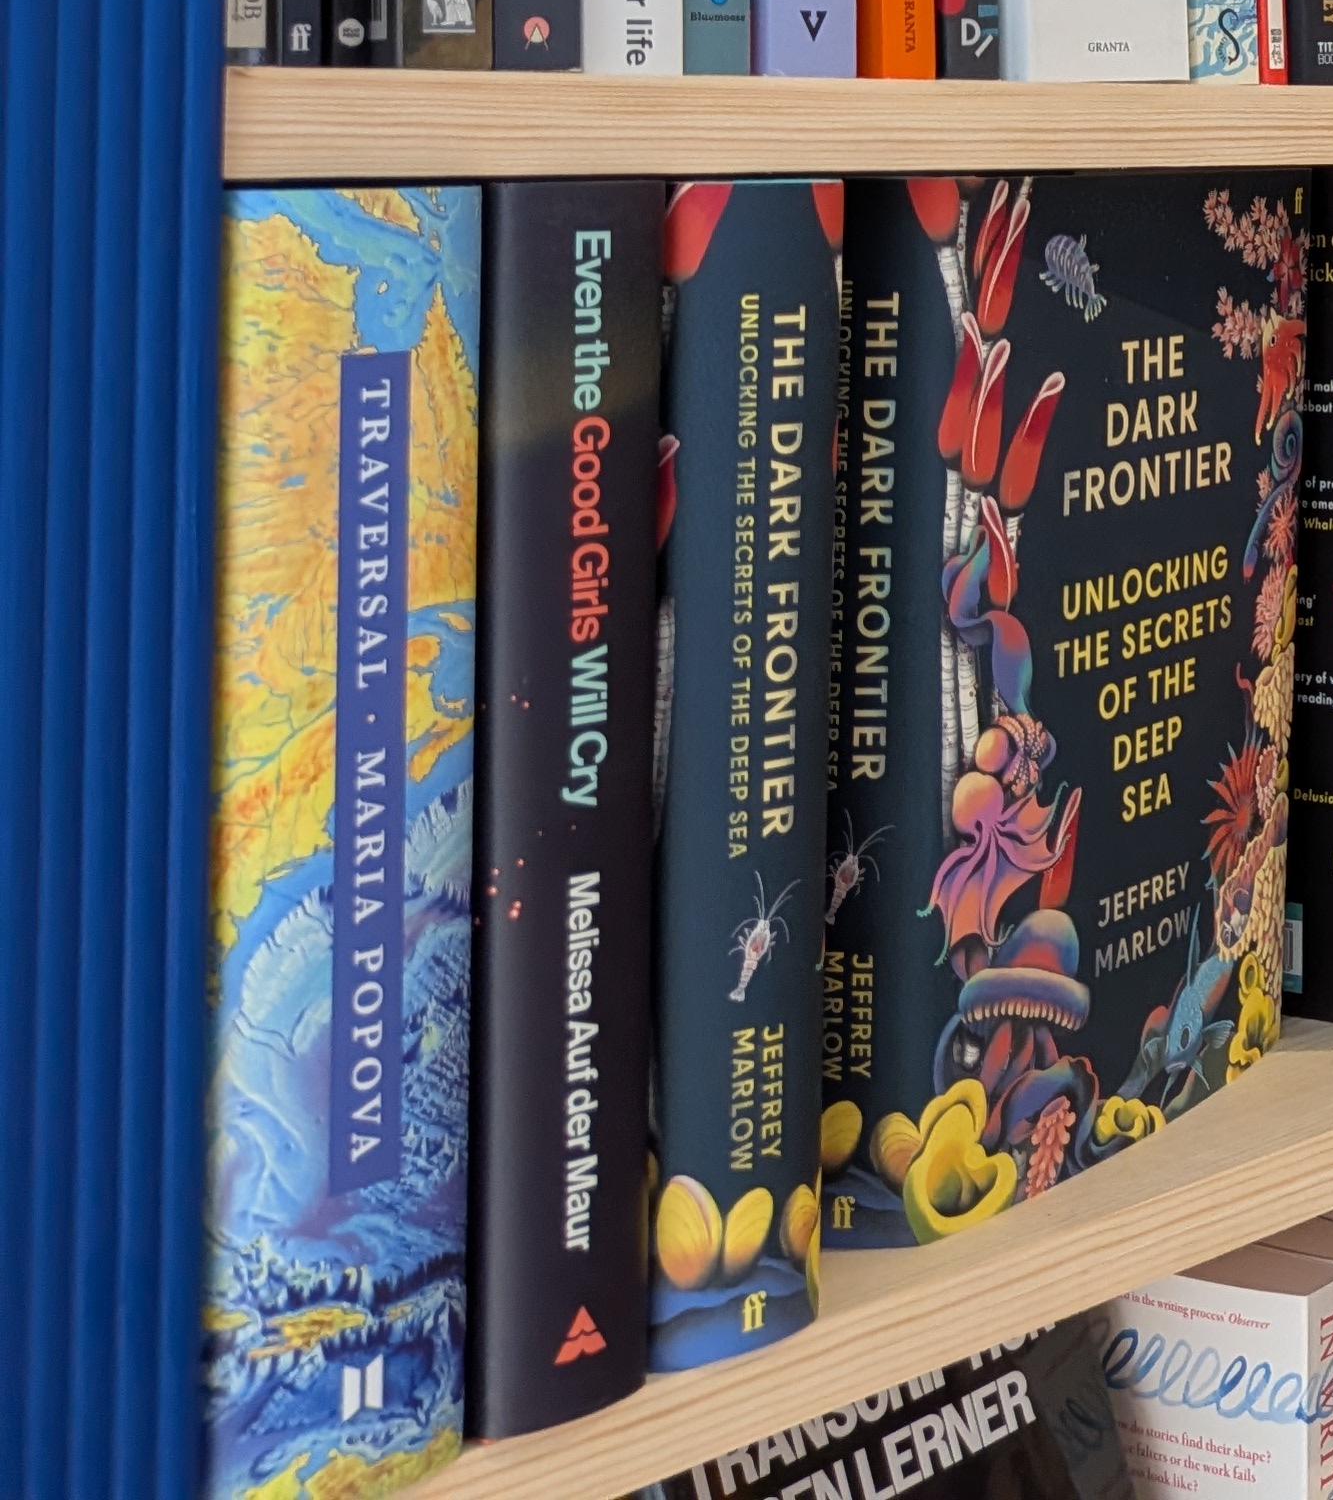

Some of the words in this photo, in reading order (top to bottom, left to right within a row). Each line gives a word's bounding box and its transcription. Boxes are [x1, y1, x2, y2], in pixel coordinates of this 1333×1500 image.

[625, 18, 653, 67] life
[573, 229, 613, 336] Even
[573, 338, 612, 412] the
[1121, 333, 1185, 385] THE
[1106, 389, 1199, 450] DARK
[571, 415, 612, 537] Good
[1062, 441, 1233, 517] FRONTIER
[358, 377, 392, 690] TRAVERSAL
[569, 541, 611, 645] Girls
[569, 643, 611, 731] Will
[562, 734, 611, 808] Cry
[353, 748, 389, 928] MARIA
[1098, 861, 1191, 929] JEFFREY
[1094, 904, 1192, 978] MARLOW
[349, 939, 385, 1165] POPOVA
